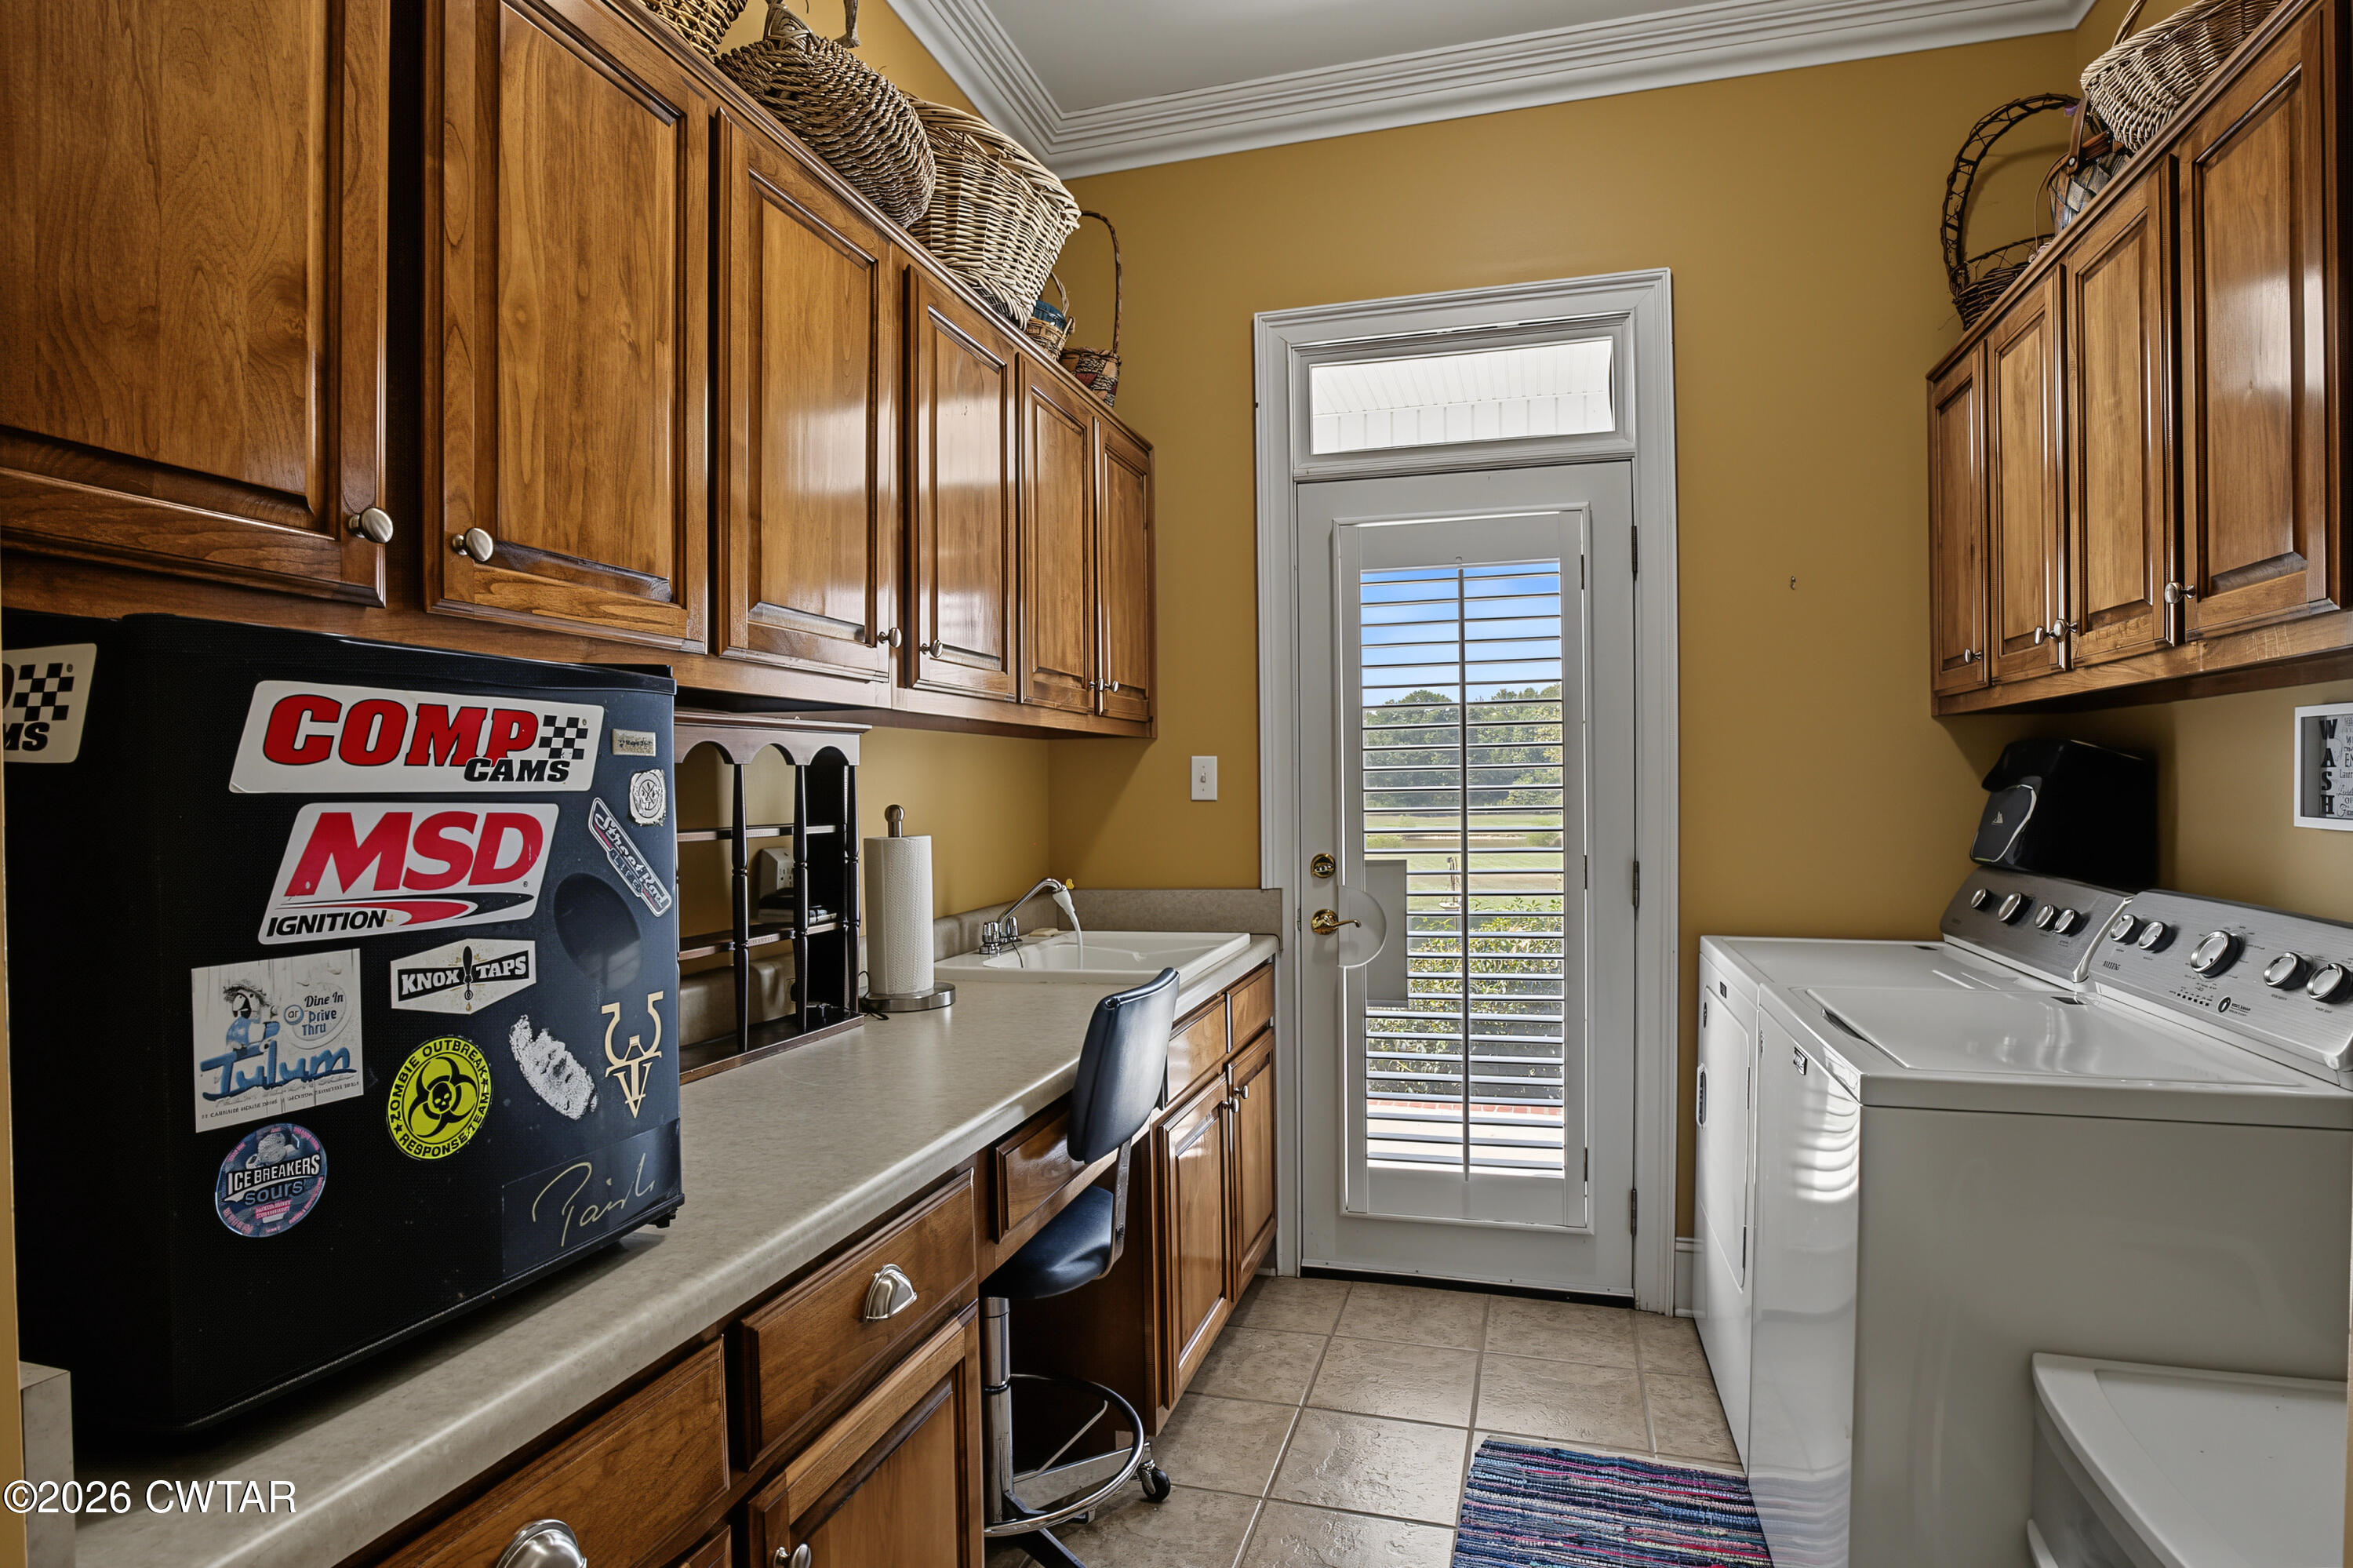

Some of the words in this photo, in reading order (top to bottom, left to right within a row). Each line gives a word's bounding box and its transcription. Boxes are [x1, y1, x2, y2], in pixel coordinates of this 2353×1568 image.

[3, 722, 50, 751] MS
[263, 694, 540, 766] COMP
[464, 757, 571, 783] CAMS
[284, 810, 544, 897] MSD
[266, 910, 388, 937] IGNITION
[401, 969, 460, 995] KNOX
[475, 955, 527, 979] TAPS
[304, 995, 330, 1008] Dine
[333, 991, 344, 1003] In
[308, 1010, 337, 1023] Drive
[302, 1023, 326, 1035] Thru
[200, 1039, 355, 1101] Tulum
[390, 1056, 420, 1123] ZOMBIE
[422, 1039, 488, 1079] OUTBREAK
[398, 1132, 469, 1157] RESPONSE
[467, 1092, 489, 1133] TEAM
[228, 1170, 252, 1195] ICE
[254, 1154, 320, 1184] BREAKERS
[245, 1181, 303, 1205] sours
